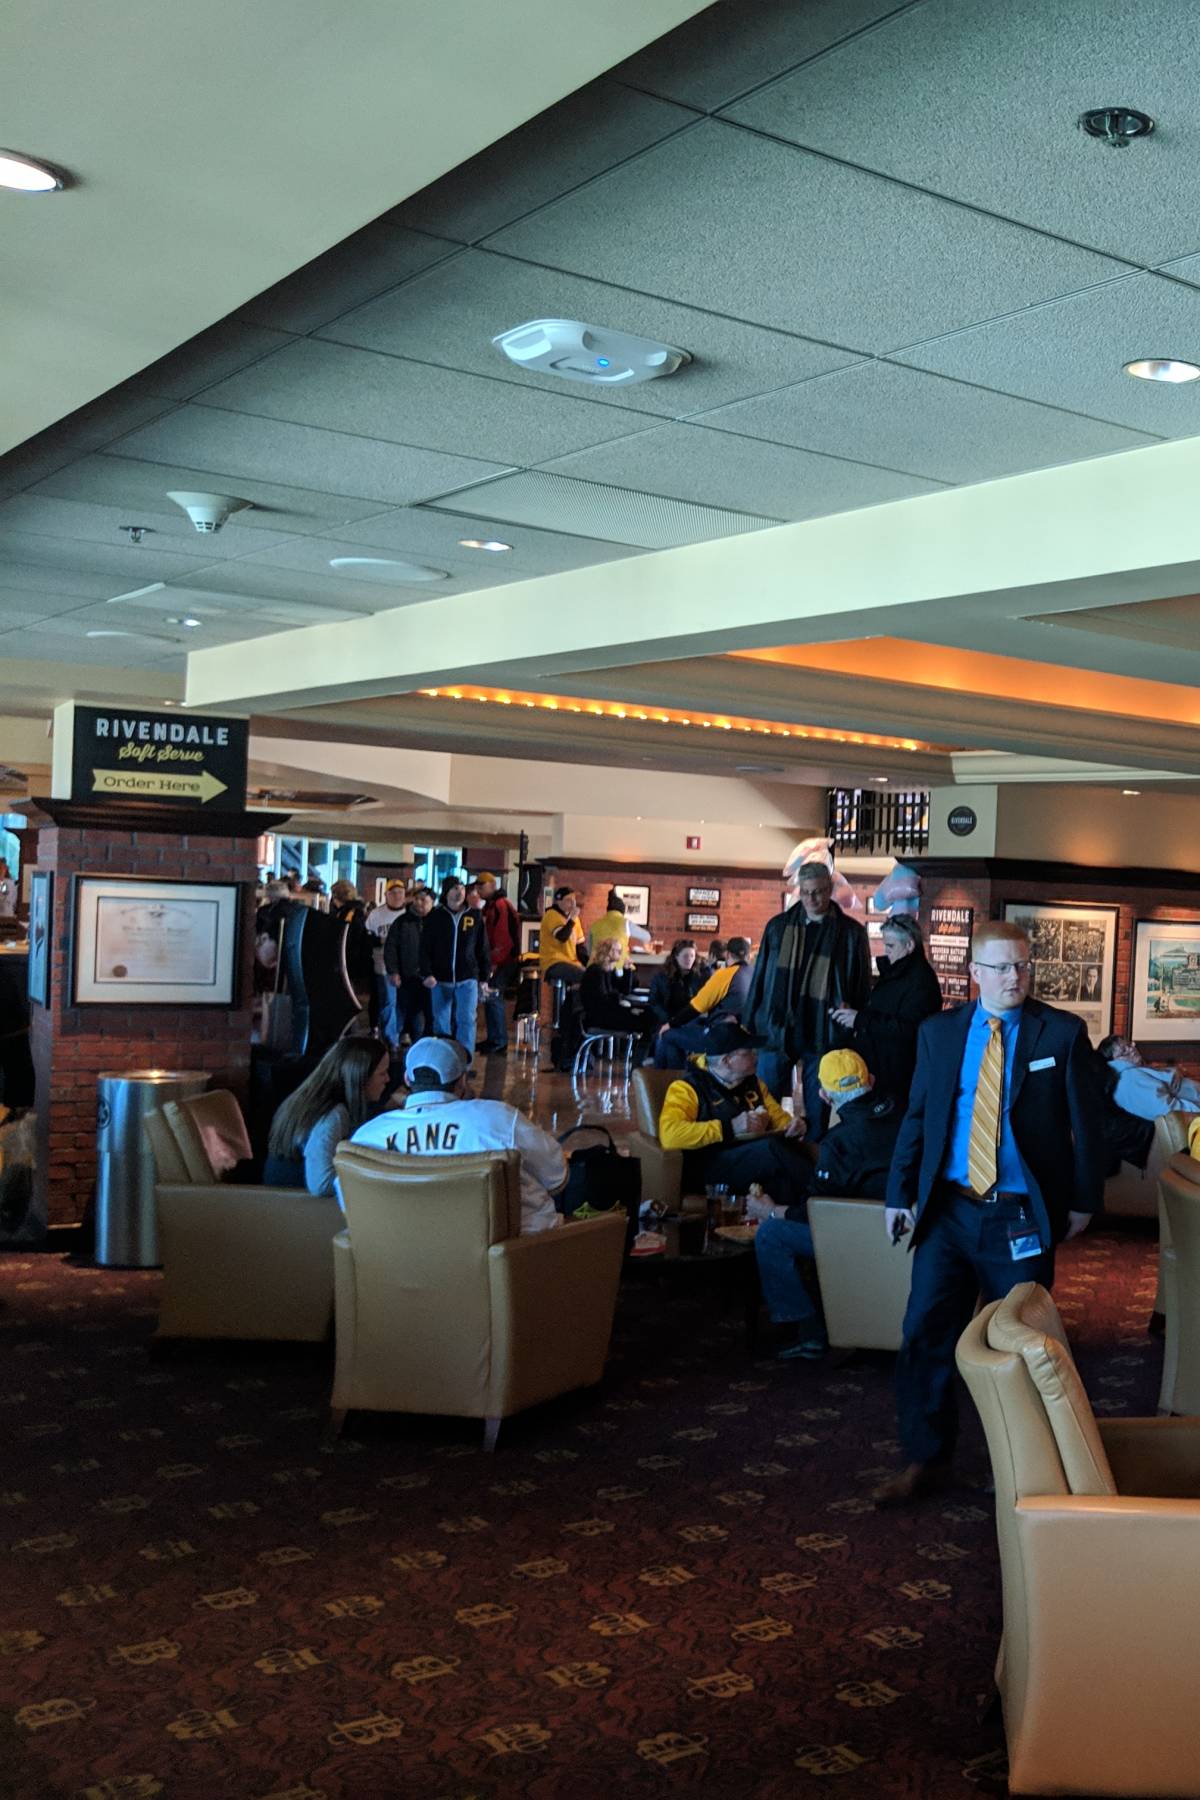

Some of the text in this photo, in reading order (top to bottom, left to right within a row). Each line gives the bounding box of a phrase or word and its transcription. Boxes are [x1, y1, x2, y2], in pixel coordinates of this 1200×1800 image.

[96, 718, 229, 746] RIVENDALE
[118, 742, 205, 763] Soft Serve
[103, 776, 200, 792] Order Here
[462, 916, 474, 931] P
[931, 909, 970, 923] RIVENDALE
[386, 1123, 460, 1154] KANG
